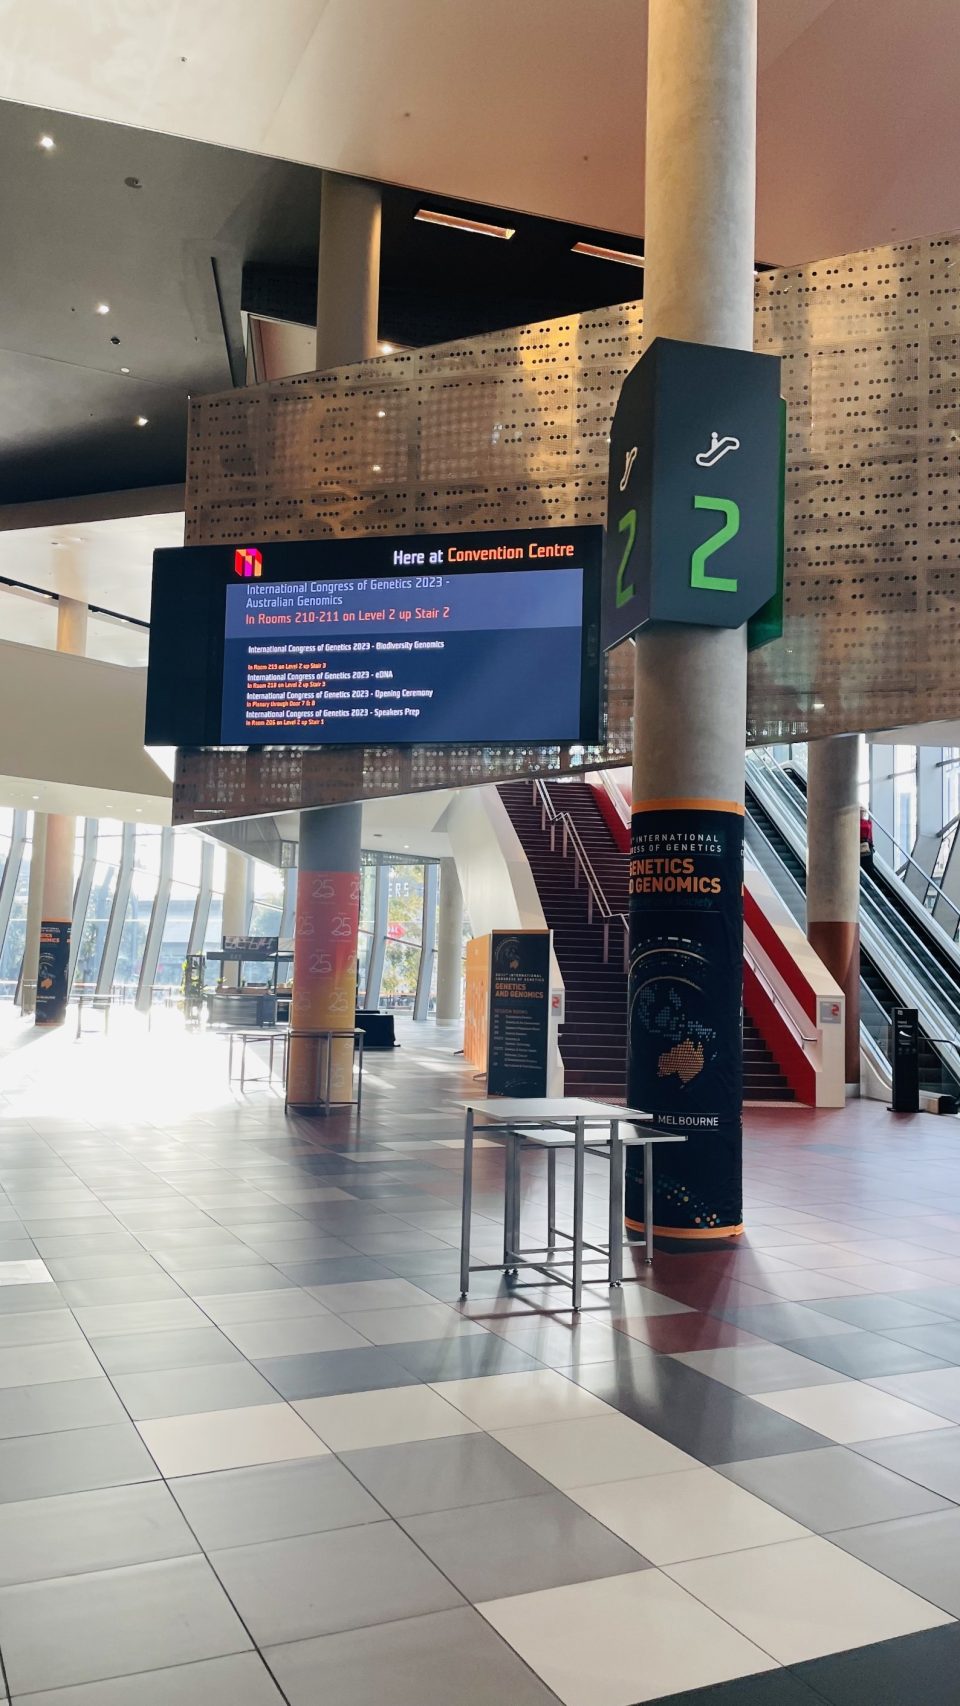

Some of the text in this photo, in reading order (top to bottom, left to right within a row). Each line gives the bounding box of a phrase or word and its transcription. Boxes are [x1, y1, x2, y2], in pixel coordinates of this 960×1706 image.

[690, 495, 740, 592] 2
[393, 543, 575, 566] Here at Convention Centre
[616, 509, 637, 608] 2
[247, 582, 307, 595] International
[310, 581, 354, 594] Congress
[357, 579, 368, 591] of
[370, 579, 412, 590] Genetics
[415, 576, 443, 588] 2023
[246, 595, 343, 608] Australian Genomics
[245, 606, 450, 625] In Rooms 210-211 on Level 2 up Stair 2
[248, 644, 287, 654] International
[288, 644, 316, 654] Congress
[317, 643, 324, 652] of
[325, 643, 352, 652] Genetics
[353, 642, 370, 651] 2023
[376, 641, 413, 651] Biodiversity
[414, 640, 445, 650] Genomics
[247, 673, 286, 681] International
[287, 672, 315, 682] Congress
[316, 671, 324, 680] of
[324, 671, 351, 680] Genetics
[352, 670, 370, 679] 2023
[375, 670, 393, 679] eDNA
[246, 692, 285, 700] International
[286, 691, 314, 701] Congress
[315, 691, 323, 699] of
[324, 690, 350, 699] Genetics
[351, 690, 369, 698] 2023
[374, 689, 401, 699] Opening
[401, 688, 433, 698] Ceremony
[245, 710, 285, 718] International
[286, 709, 314, 719] Congress
[315, 709, 323, 717] of
[323, 709, 350, 717] Genetics
[351, 708, 369, 717] 2023
[374, 708, 403, 718] Speakers
[404, 707, 420, 717] Prep
[636, 833, 719, 843] INTERNATIONAL
[648, 844, 660, 852] OF
[665, 843, 722, 853] GENETICS
[635, 876, 721, 894] GENOMICS
[331, 916, 352, 936] 25
[309, 953, 333, 973] 25
[495, 982, 527, 991] GENETICS
[495, 990, 544, 999] AND GENOMICS
[658, 1114, 719, 1127] MELBOURNE
